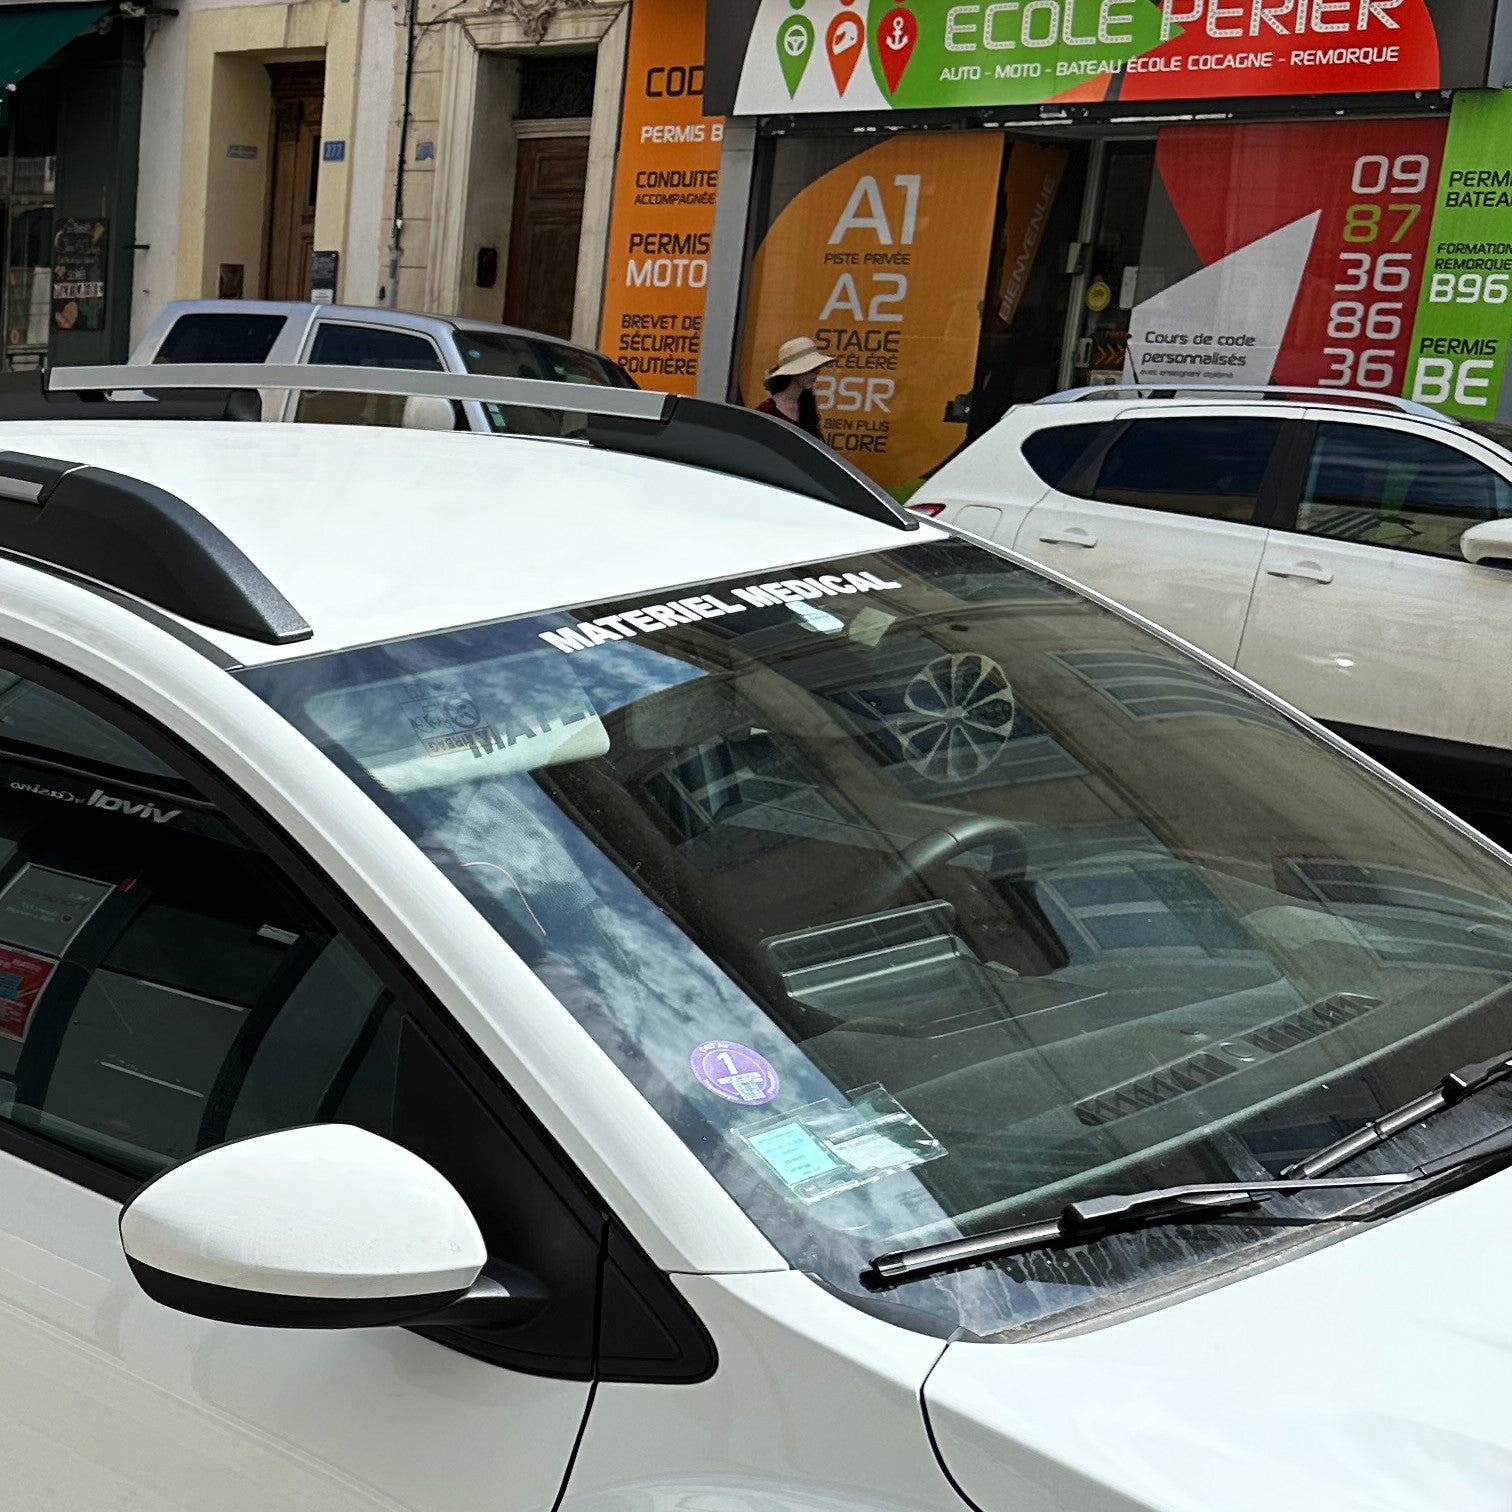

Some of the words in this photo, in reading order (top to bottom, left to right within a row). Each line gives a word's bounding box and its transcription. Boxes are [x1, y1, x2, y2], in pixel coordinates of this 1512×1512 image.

[945, 0, 1136, 51] ECOLE
[940, 65, 981, 81] AUTO
[995, 63, 1041, 79] MOTO
[1056, 59, 1121, 77] BATEAU
[1126, 55, 1182, 73] ÉCOLE
[1188, 52, 1273, 71] COCAGNE
[1290, 46, 1400, 66] REMORQUE
[645, 65, 705, 97] COD
[640, 124, 705, 144] PERMIS
[711, 123, 725, 142] B
[635, 170, 718, 189] CONDUITE
[1351, 154, 1430, 194] 09
[1449, 170, 1512, 188] PERM
[634, 192, 717, 206] ACCOMPAGNÉE
[827, 174, 921, 245] A1
[1445, 191, 1512, 208] BATEA
[1342, 203, 1422, 243] 87
[629, 233, 712, 255] PERMIS
[999, 173, 1055, 321] BIENVENUE
[824, 252, 860, 265] PISTE
[863, 251, 911, 265] PRIVÉE
[1434, 258, 1512, 271] REMORQUE
[625, 258, 708, 288] MOTO
[1334, 252, 1413, 292] 36
[818, 272, 908, 322] A2
[1429, 273, 1510, 304] B96
[621, 314, 678, 331] BREVET
[682, 315, 702, 331] DE
[1326, 301, 1403, 340] 86
[619, 331, 700, 353] SÉCURITÉ
[815, 328, 901, 353] STAGE
[1144, 330, 1188, 345] Cours
[1193, 332, 1213, 346] de
[1217, 334, 1256, 347] code
[1419, 337, 1498, 355] PERMIS
[617, 354, 698, 376] ROUTIÈRE
[1141, 351, 1247, 367] personnalisés
[1318, 347, 1395, 389] 36
[1411, 357, 1494, 406] BE
[856, 420, 890, 433] PLUS
[538, 594, 747, 654] MATERIEL
[731, 571, 902, 608] MEDICAL
[716, 1051, 739, 1075] 1
